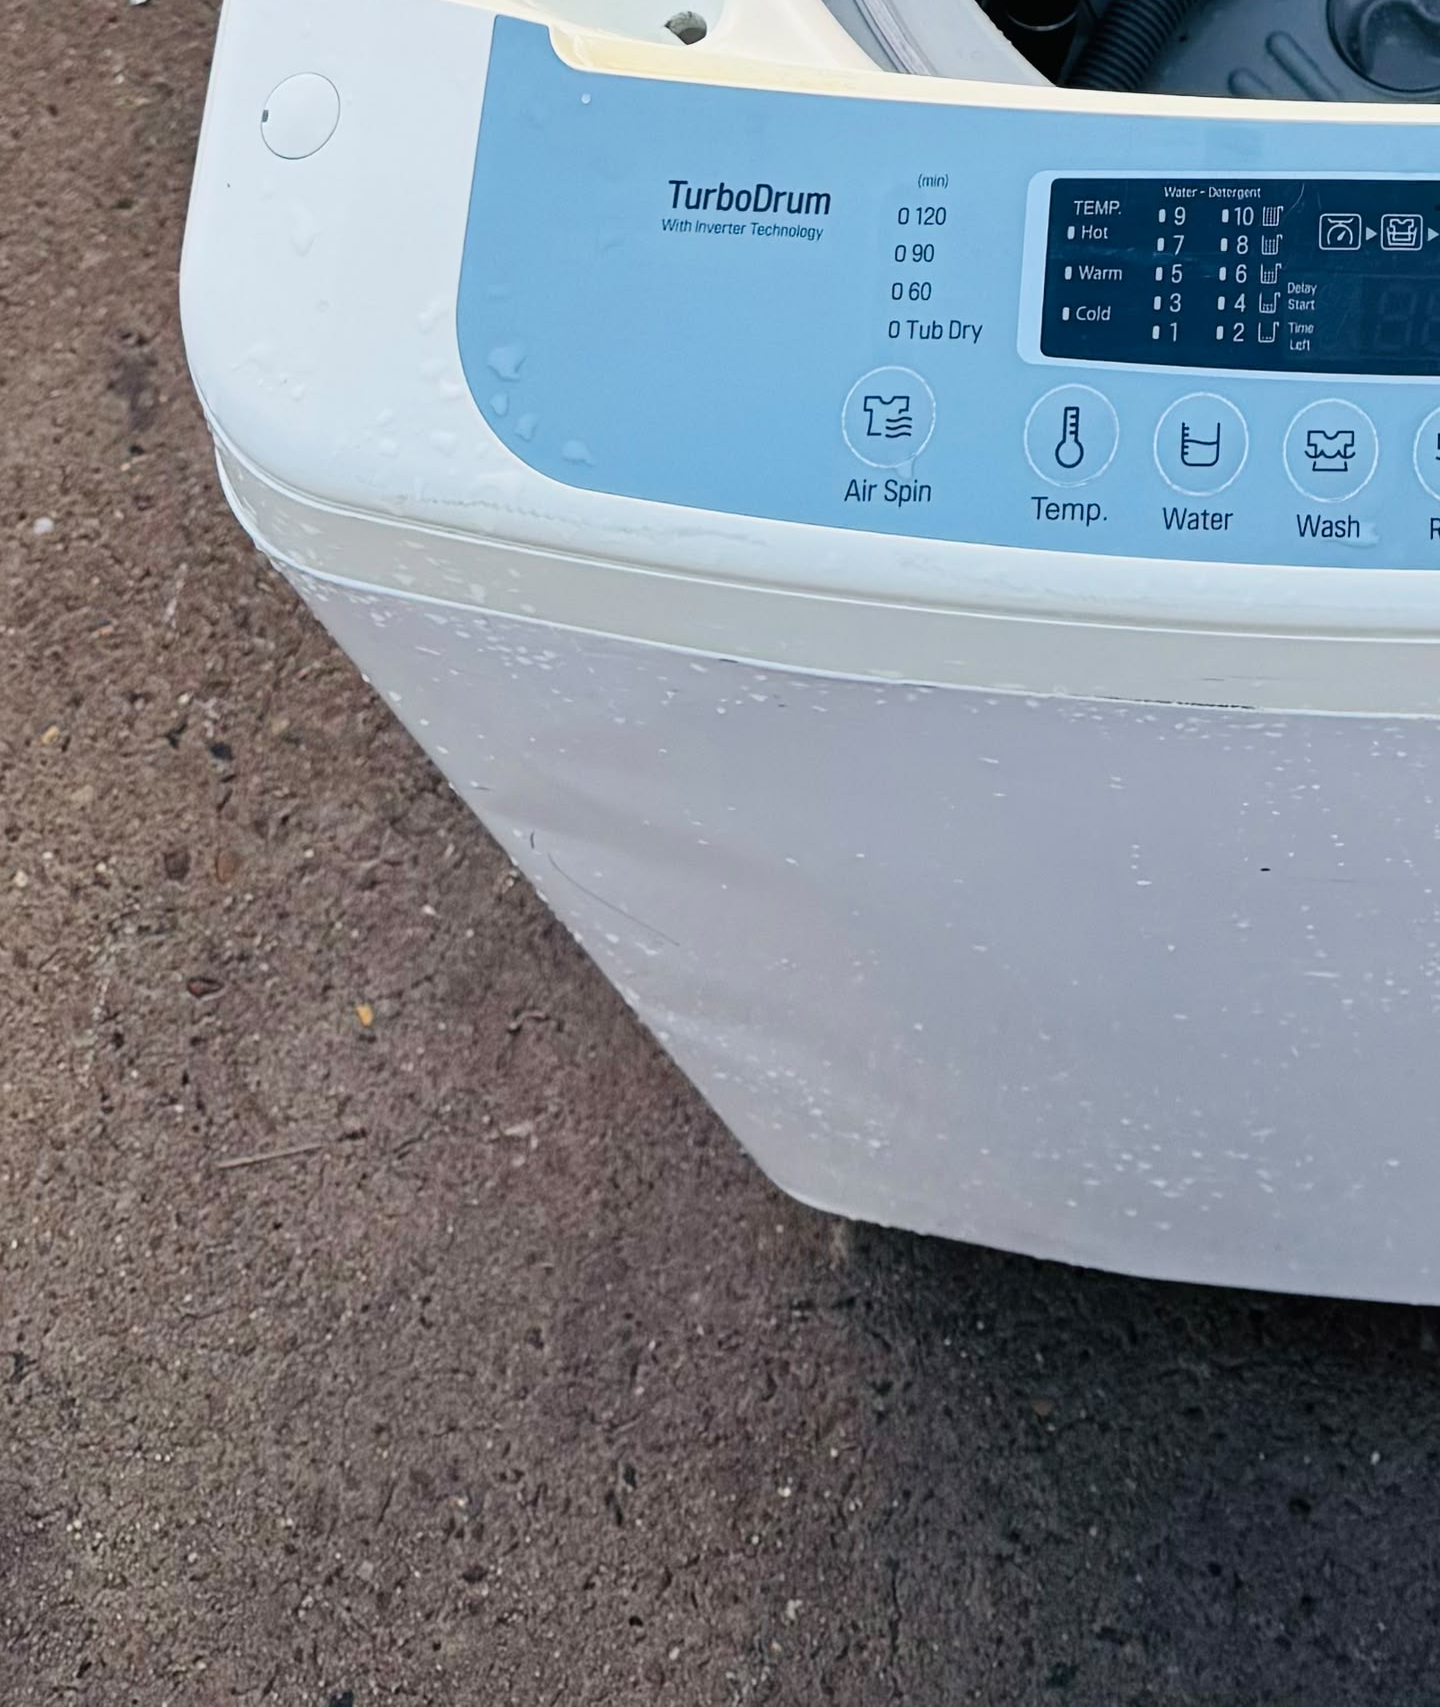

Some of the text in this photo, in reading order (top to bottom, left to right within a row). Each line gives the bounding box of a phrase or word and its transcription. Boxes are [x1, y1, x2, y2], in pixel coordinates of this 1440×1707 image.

[917, 173, 949, 189] (min)
[668, 180, 832, 216] TurboDrum
[915, 206, 947, 227] 120
[1073, 200, 1122, 217] TEMP.
[1174, 206, 1186, 226] 9
[1234, 206, 1254, 226] 10
[661, 218, 824, 241] With Inverter Technology
[1081, 225, 1108, 240] Hot
[911, 244, 935, 264] 90
[1173, 235, 1185, 256] 7
[1236, 235, 1249, 255] 8
[1078, 266, 1123, 281] Warm
[1171, 264, 1183, 283] 5
[1235, 264, 1247, 283] 6
[908, 281, 932, 302] 60
[1287, 282, 1317, 295] Delay
[1169, 293, 1182, 313] 3
[1234, 293, 1246, 313] 4
[1288, 299, 1315, 310] Start
[1075, 306, 1111, 322] Cold
[906, 320, 982, 344] Tub Dry
[1170, 322, 1178, 342] 1
[1233, 322, 1245, 342] 2
[1288, 322, 1314, 334] Time
[1289, 340, 1310, 351] Left
[844, 479, 932, 508] Air Spin
[1031, 496, 1108, 527] Temp.
[1163, 508, 1233, 531] Water
[1297, 515, 1360, 539] Wash
